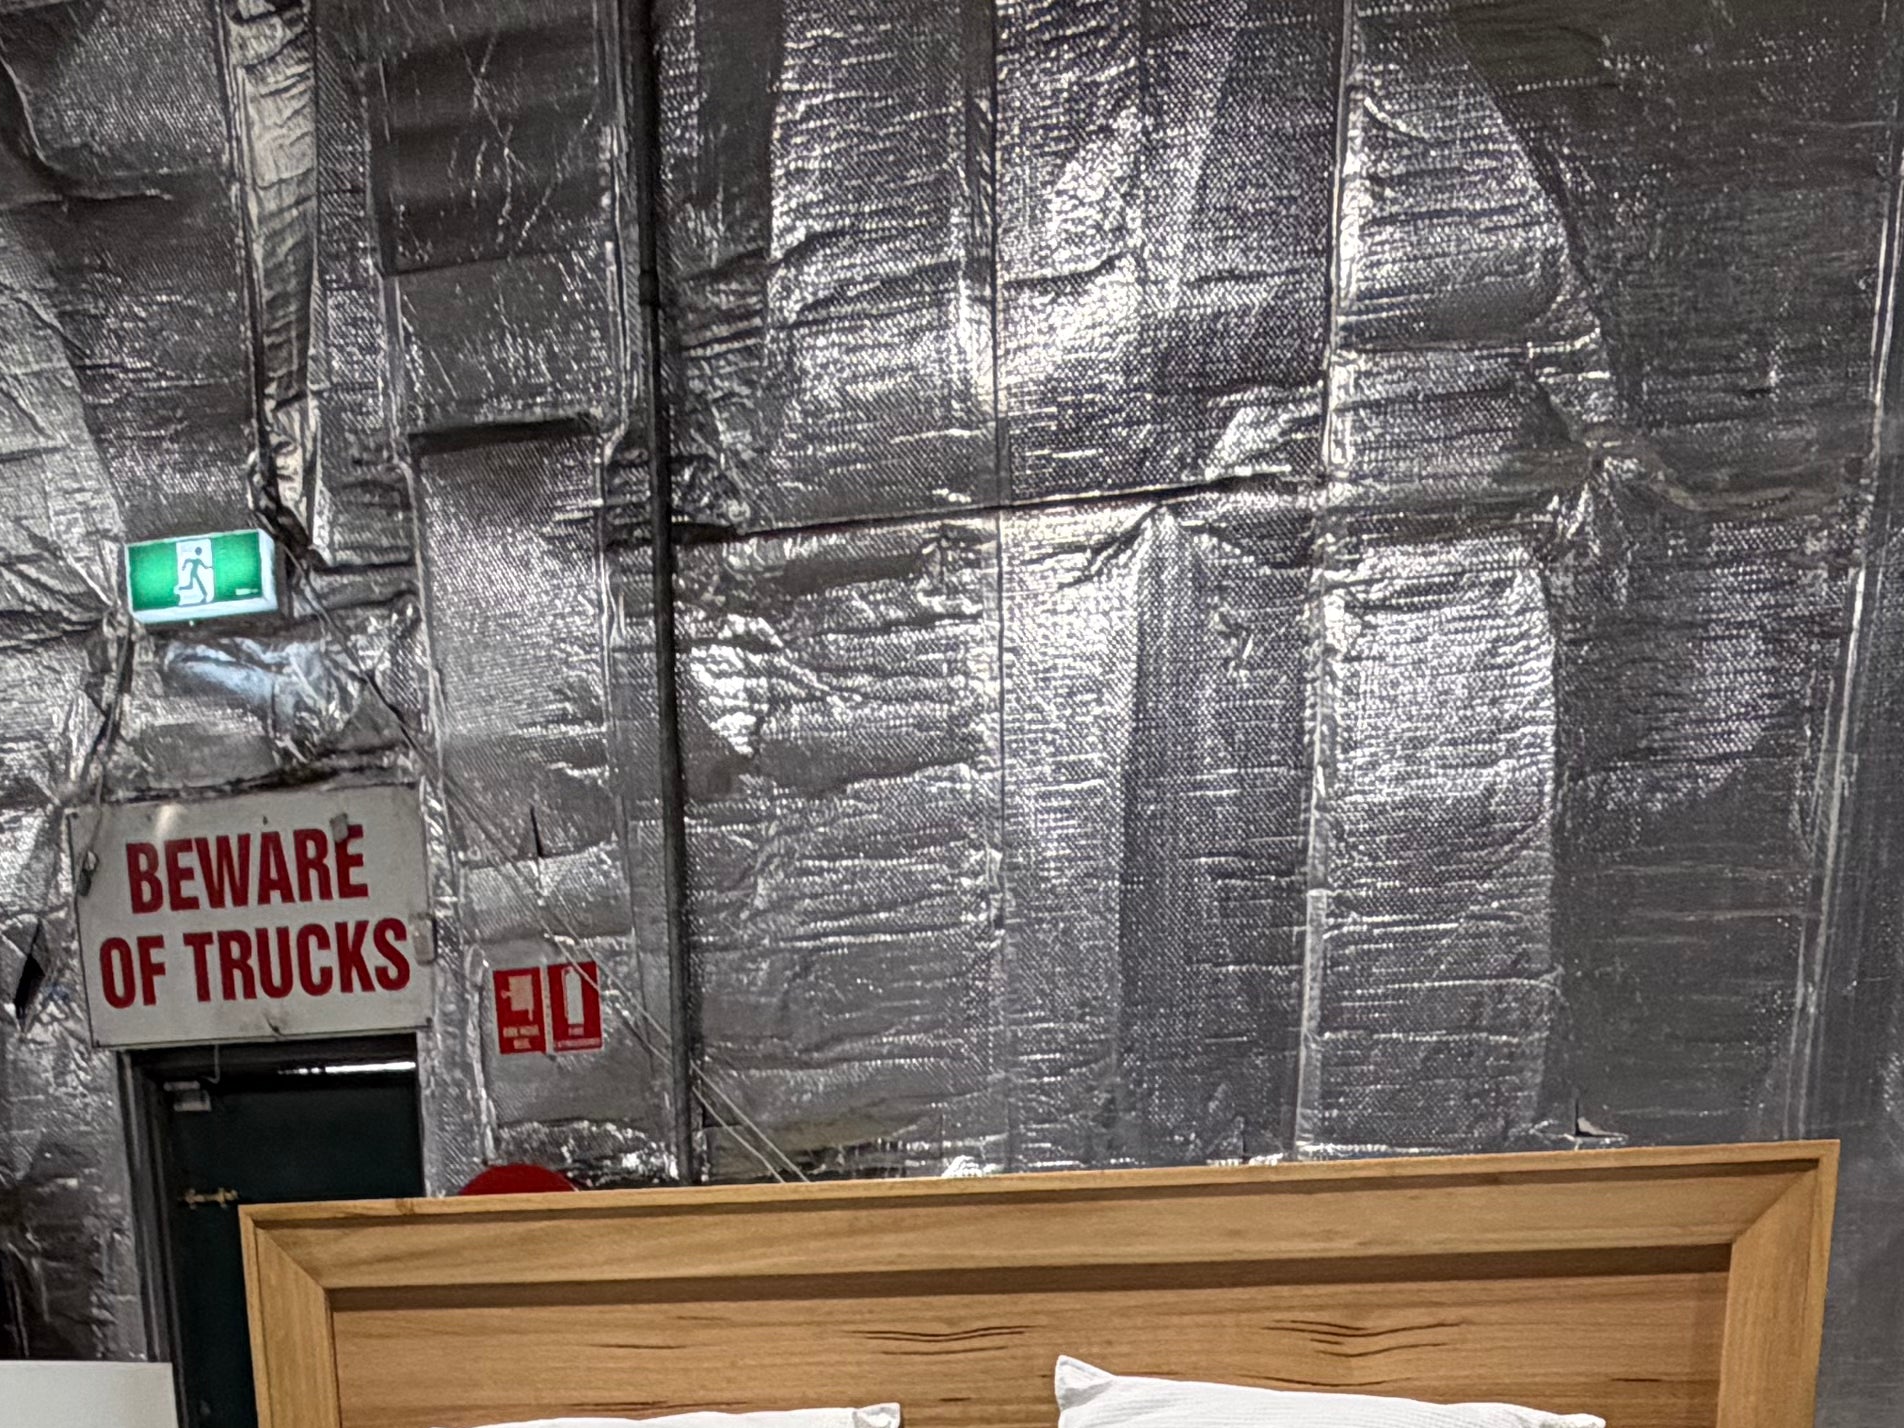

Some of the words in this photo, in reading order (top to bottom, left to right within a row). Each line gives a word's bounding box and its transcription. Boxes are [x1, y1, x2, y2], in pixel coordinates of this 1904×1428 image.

[125, 823, 369, 915] BEWARE
[99, 934, 167, 1010] OF
[183, 917, 411, 1003] TRUCKS
